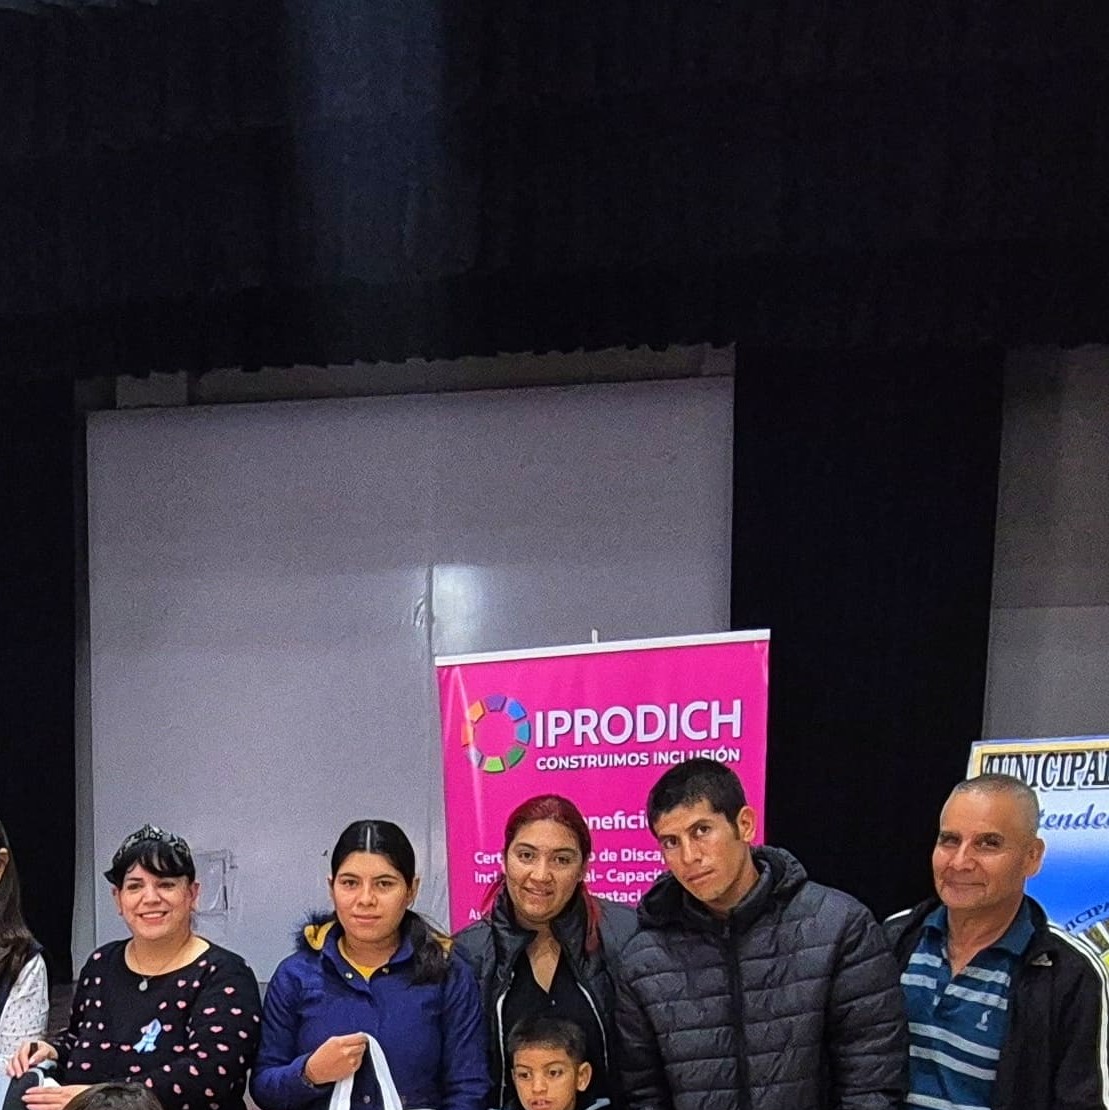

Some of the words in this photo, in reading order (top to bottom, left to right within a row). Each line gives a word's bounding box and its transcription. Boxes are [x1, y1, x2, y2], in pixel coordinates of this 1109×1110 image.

[535, 699, 741, 748] IPRODICH
[536, 753, 649, 771] CONSTRUIMOS
[474, 851, 502, 865] Cert
[599, 848, 617, 862] de
